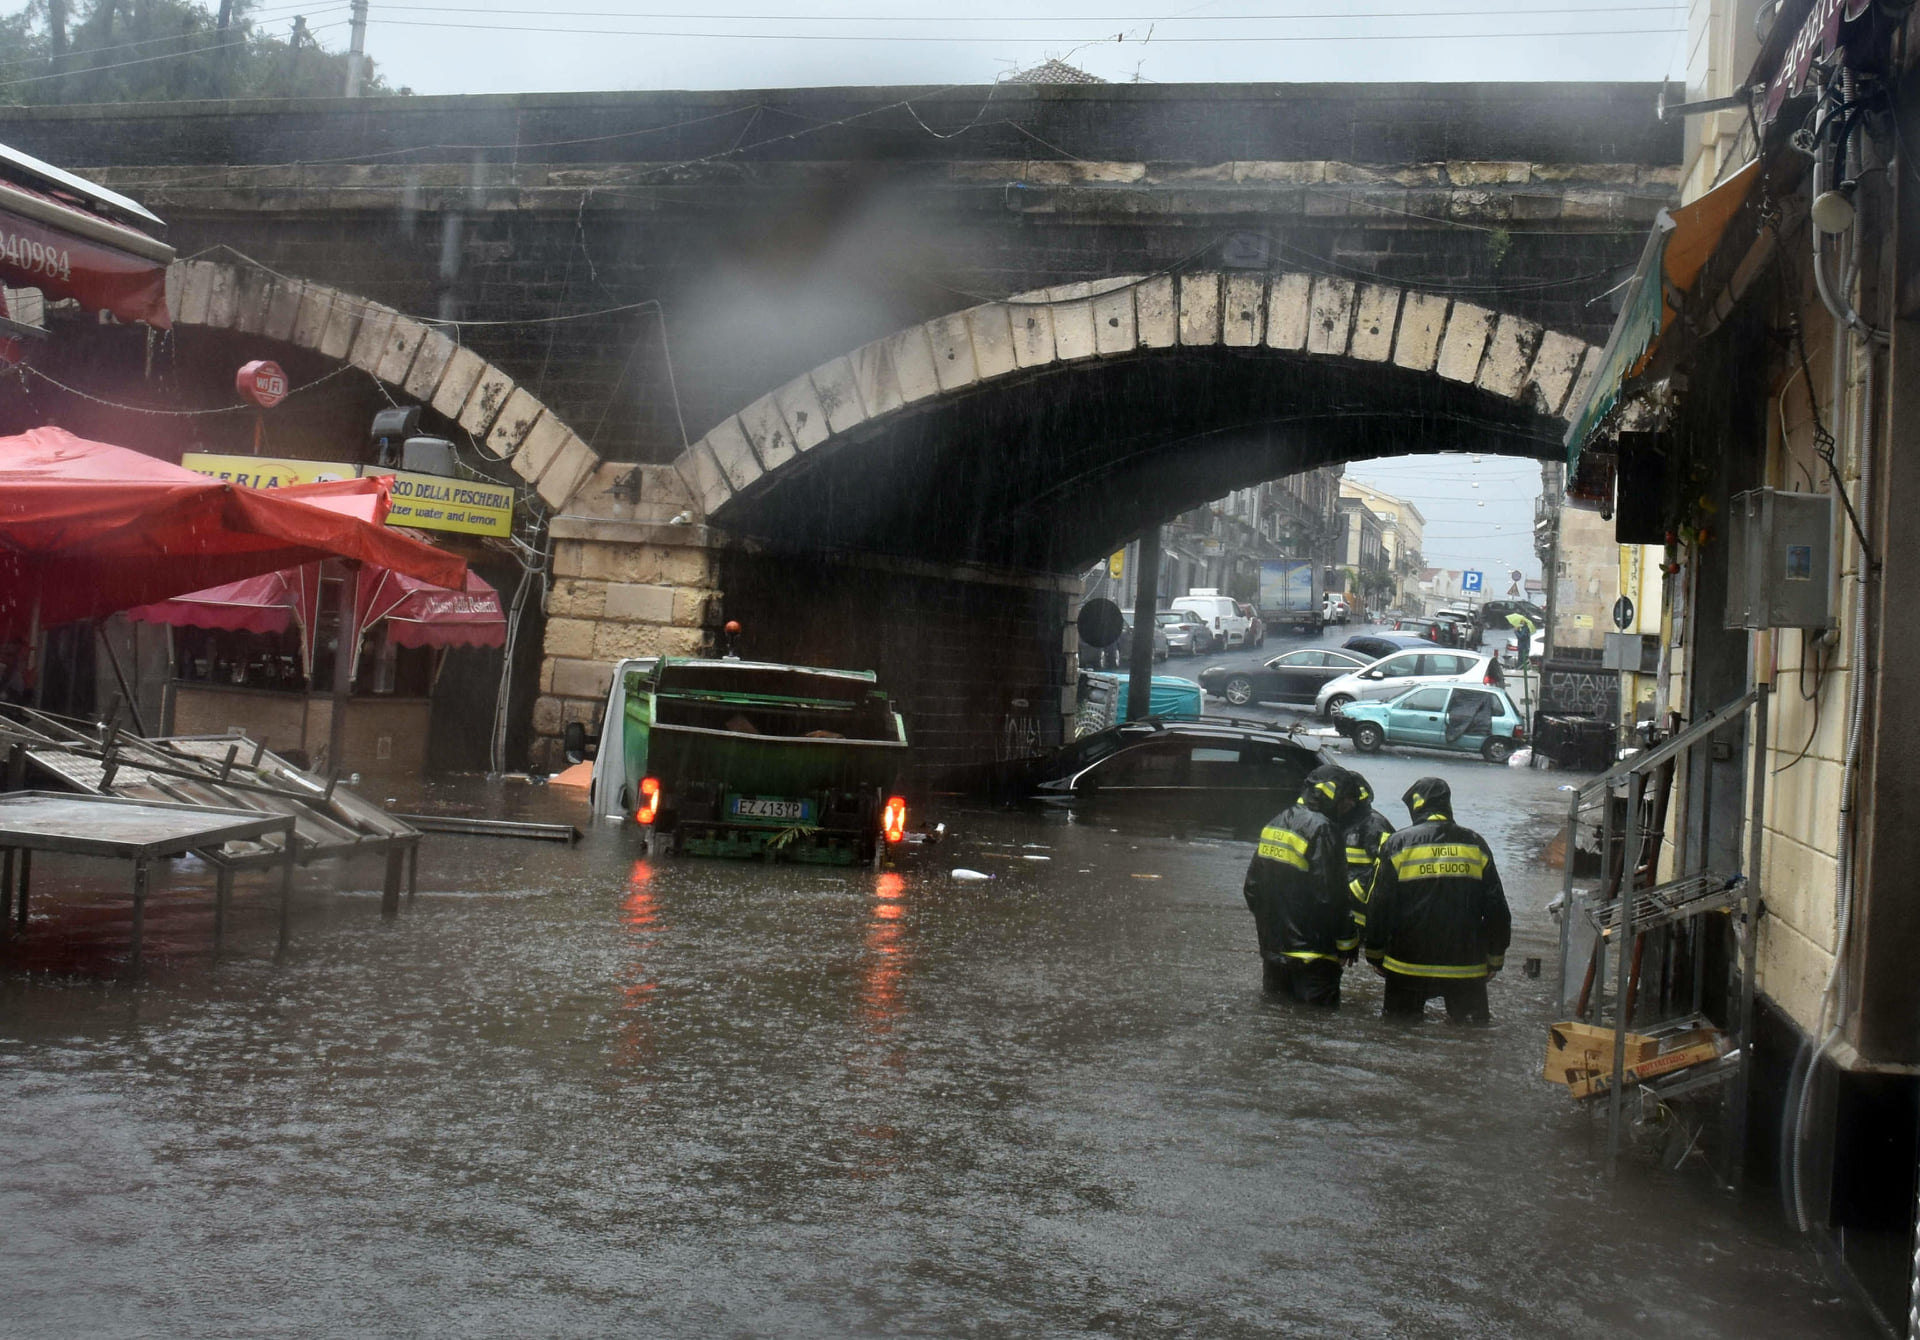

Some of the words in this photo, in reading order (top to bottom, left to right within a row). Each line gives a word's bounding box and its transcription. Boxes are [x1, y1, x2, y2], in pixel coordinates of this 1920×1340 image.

[415, 483, 450, 502] DELLA
[452, 488, 511, 510] PESCHERIA
[415, 508, 443, 520] water
[446, 511, 465, 522] and
[467, 512, 497, 526] lemon
[1466, 573, 1479, 589] P
[1550, 672, 1619, 691] CATANIA
[740, 801, 756, 814] EZ
[760, 802, 800, 817] 413YP
[1431, 847, 1458, 857] VIGILI
[1419, 864, 1437, 875] DEL
[1439, 863, 1471, 874] FUOCO
